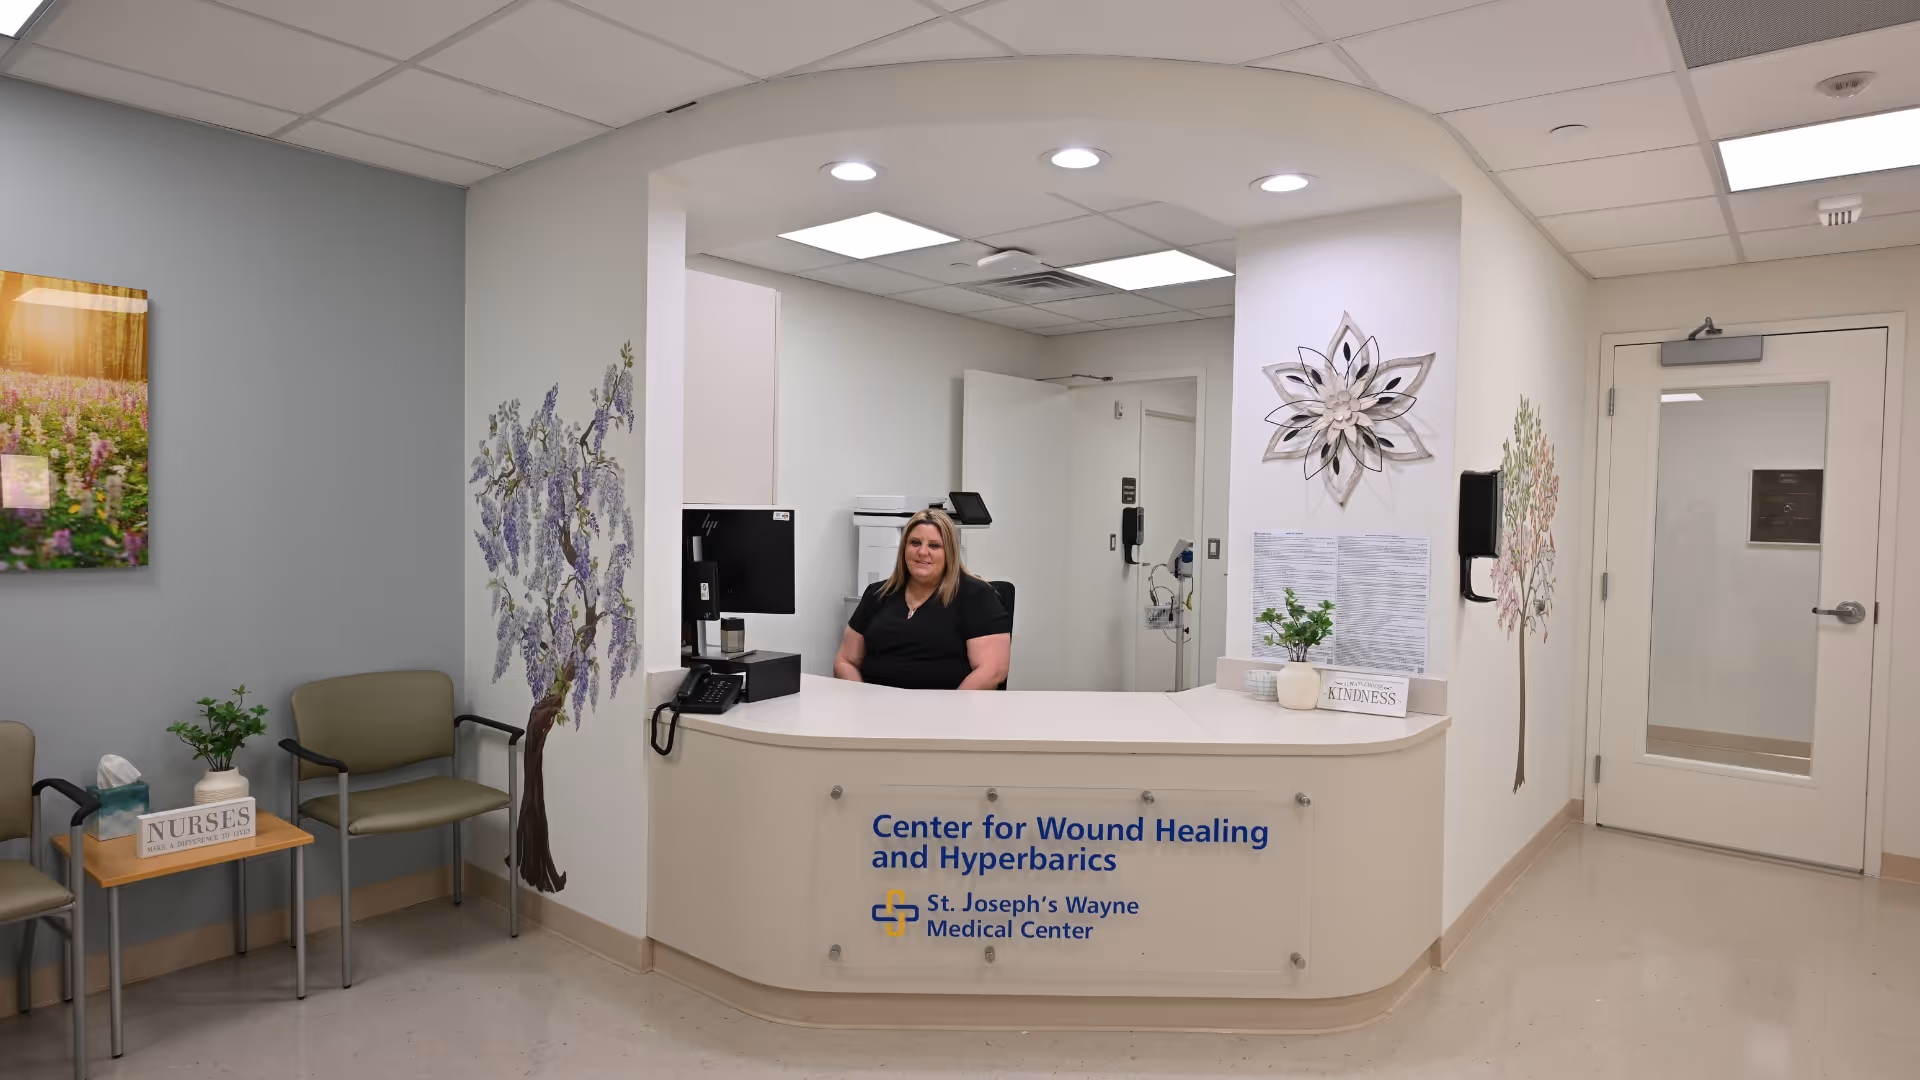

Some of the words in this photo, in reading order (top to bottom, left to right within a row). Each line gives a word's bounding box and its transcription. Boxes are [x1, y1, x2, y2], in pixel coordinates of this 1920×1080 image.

[1328, 686, 1397, 705] KINDNESS
[147, 806, 250, 844] NURSES
[872, 814, 973, 840] Center
[983, 813, 1027, 840] for
[1036, 816, 1145, 842] Wound
[1156, 818, 1269, 851] Healing
[147, 844, 166, 854] MAKE
[169, 841, 175, 850] A
[177, 834, 219, 848] DIFFERENCE
[222, 832, 230, 840] TO
[233, 828, 251, 838] LIVES
[871, 844, 929, 869] and
[940, 845, 1117, 877] Hyperbarics
[927, 893, 955, 912] St.
[962, 892, 1058, 918] Joseph's
[1065, 895, 1139, 919] Wayne
[927, 919, 1013, 938] Medical
[1020, 920, 1093, 939] Center
